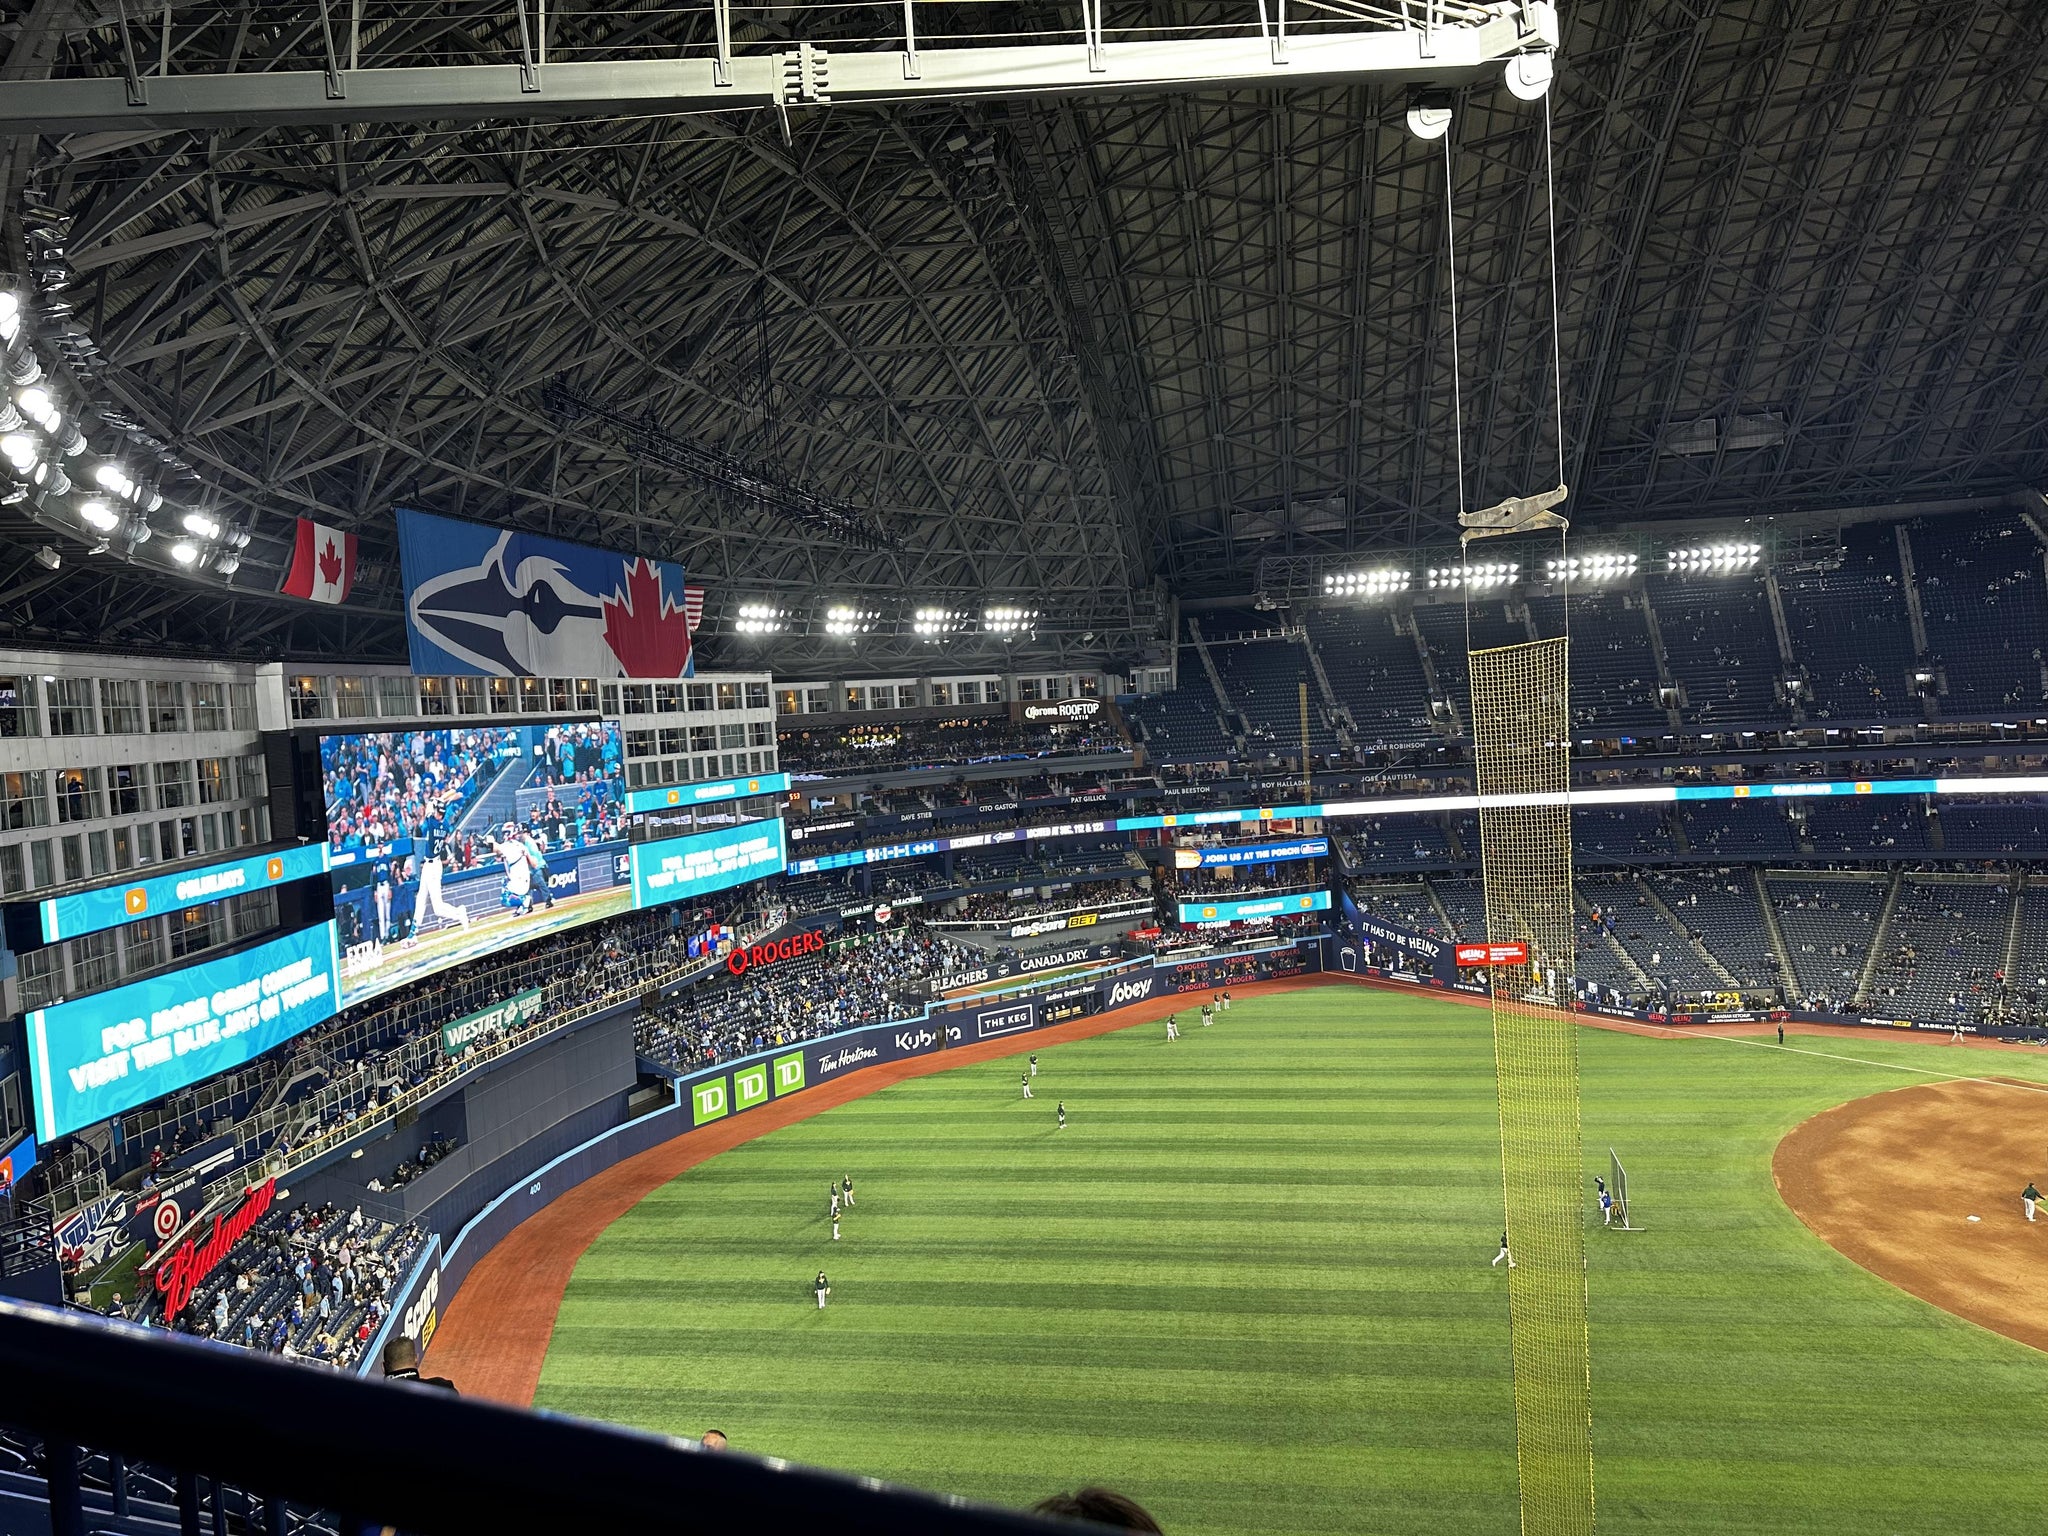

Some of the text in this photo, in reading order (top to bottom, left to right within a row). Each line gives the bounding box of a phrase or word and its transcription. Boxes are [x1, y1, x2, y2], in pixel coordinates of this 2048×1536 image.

[1025, 703, 1100, 720] Corona ROOFTOP
[1364, 742, 1426, 752] JACKIE ROBINSON
[1276, 780, 1311, 788] HALLADAY
[1382, 773, 1417, 781] BAUTISTA
[1181, 786, 1210, 794] BEESTON
[1083, 794, 1107, 802] GILLICK
[979, 803, 1018, 812] CITO GASTON
[901, 811, 932, 821] DAVE STIEB
[1204, 854, 1227, 863] JOIN
[1230, 852, 1242, 861] US
[1243, 851, 1254, 860] AT
[1255, 849, 1269, 859] THE
[840, 906, 863, 917] CANADA
[862, 903, 874, 912] DRY
[1011, 919, 1067, 938] theScore
[1070, 914, 1096, 927] BET
[1362, 921, 1370, 931] IT
[1370, 925, 1385, 938] HAS
[1386, 930, 1396, 942] TO
[1397, 934, 1406, 945] BE
[1409, 937, 1440, 958] HEINZ
[752, 930, 824, 967] ROGERS
[1276, 948, 1301, 957] ROGERS
[1459, 948, 1486, 959] HEINZ
[1020, 954, 1065, 971] CANADA
[1184, 961, 1209, 970] ROGERS
[1230, 954, 1256, 964] ROGERS
[1231, 975, 1257, 984] ROGERS
[1277, 968, 1302, 977] ROGERS
[931, 968, 988, 993] BLEACHERS
[1185, 982, 1210, 991] ROGERS
[1045, 992, 1063, 1002] Active
[1109, 978, 1153, 1006] Sobeys
[519, 993, 542, 1011] FLIGHT
[101, 1017, 149, 1054] FOR
[151, 996, 210, 1038] MORE
[211, 979, 261, 1016] GREAT
[984, 1012, 1027, 1029] THE KEG
[1647, 1013, 1667, 1023] HEINZ
[1672, 1014, 1693, 1023] HEINZ
[1770, 1012, 1792, 1020] HEINZ
[1918, 1022, 1957, 1031] BASELINE
[68, 1050, 131, 1093] VISIT
[131, 1036, 173, 1071] THE
[174, 1018, 222, 1056] BLUE
[221, 1004, 261, 1038] JAYS
[259, 994, 280, 1021] ON
[819, 1047, 878, 1074] Tim Hortons
[777, 1061, 801, 1086] TD
[738, 1072, 764, 1100] TD
[696, 1086, 724, 1115] TD
[161, 1176, 196, 1200] HOME RUN ZONE
[530, 1181, 541, 1195] 400
[156, 1177, 276, 1322] Budweiser
[401, 1268, 438, 1340] Score
